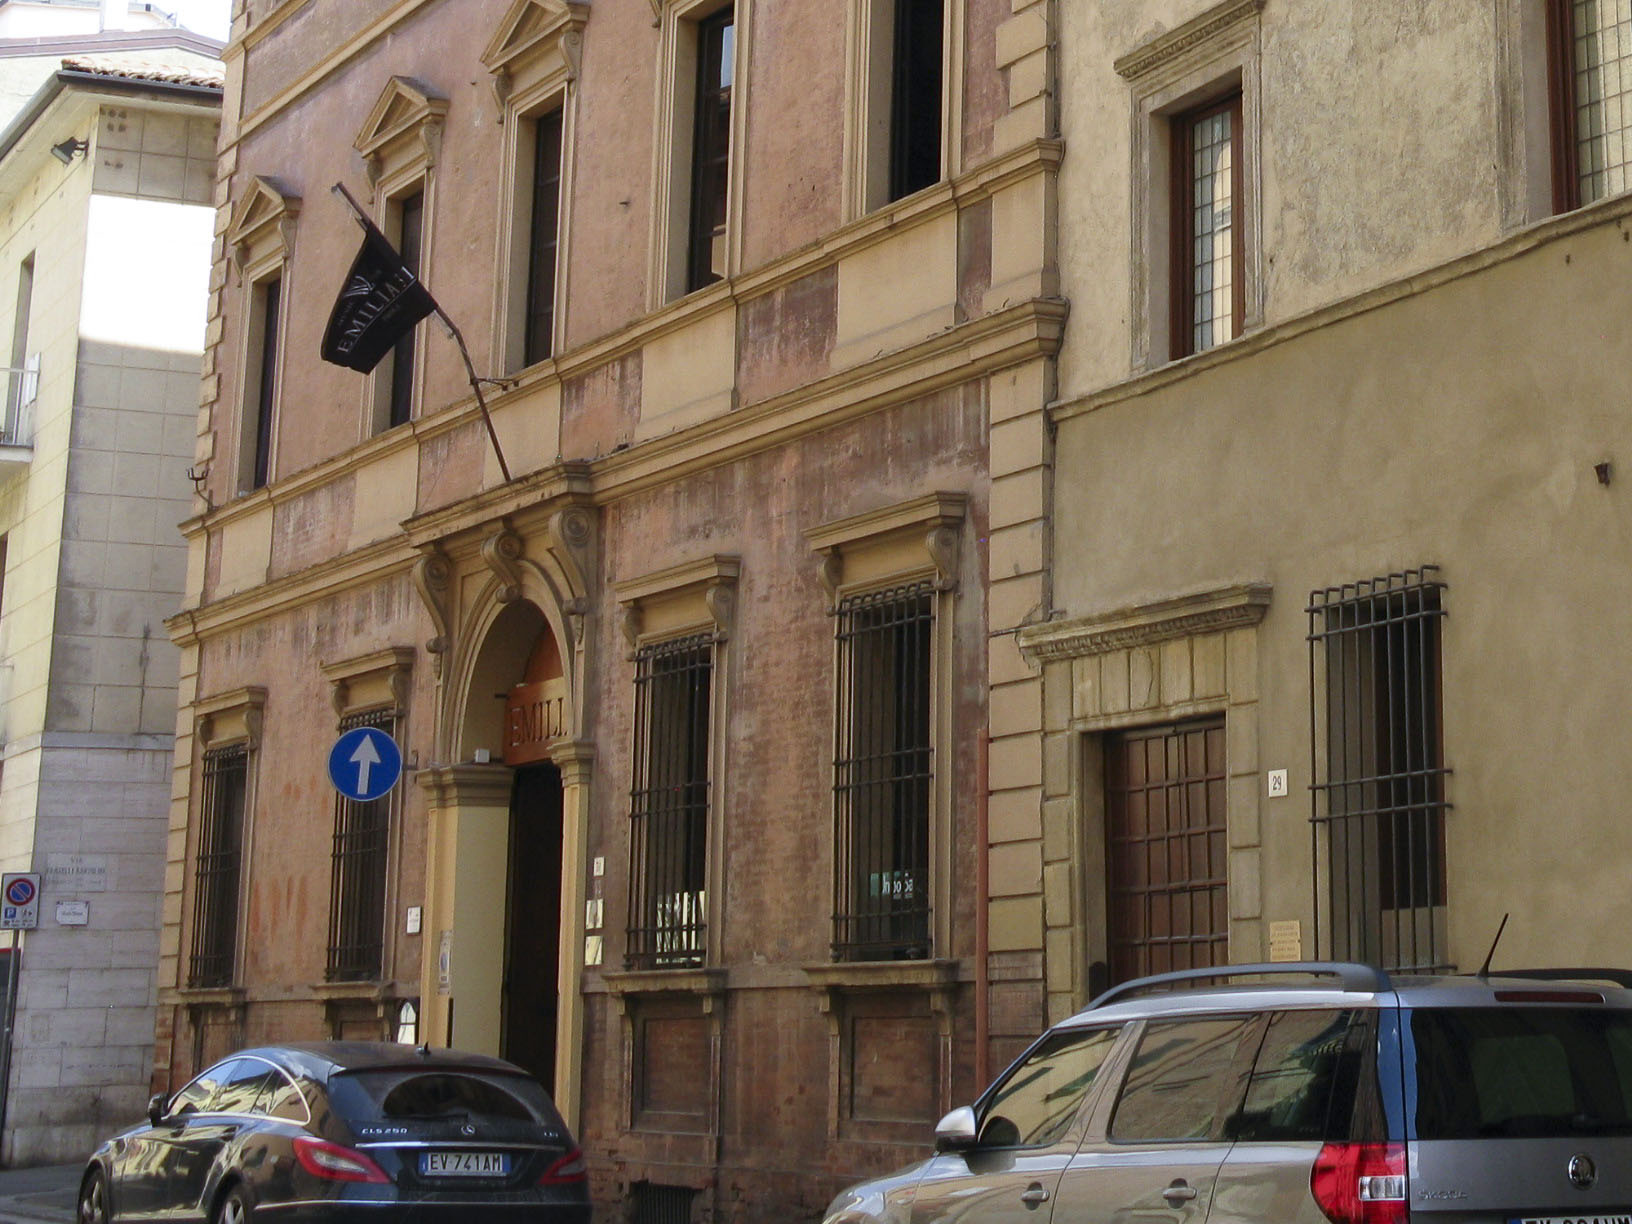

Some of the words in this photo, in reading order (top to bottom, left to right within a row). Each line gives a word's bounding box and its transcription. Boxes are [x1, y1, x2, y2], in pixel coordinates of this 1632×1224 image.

[1272, 776, 1282, 791] 29
[430, 1154, 449, 1170] EV
[454, 1152, 501, 1170] 741AM
